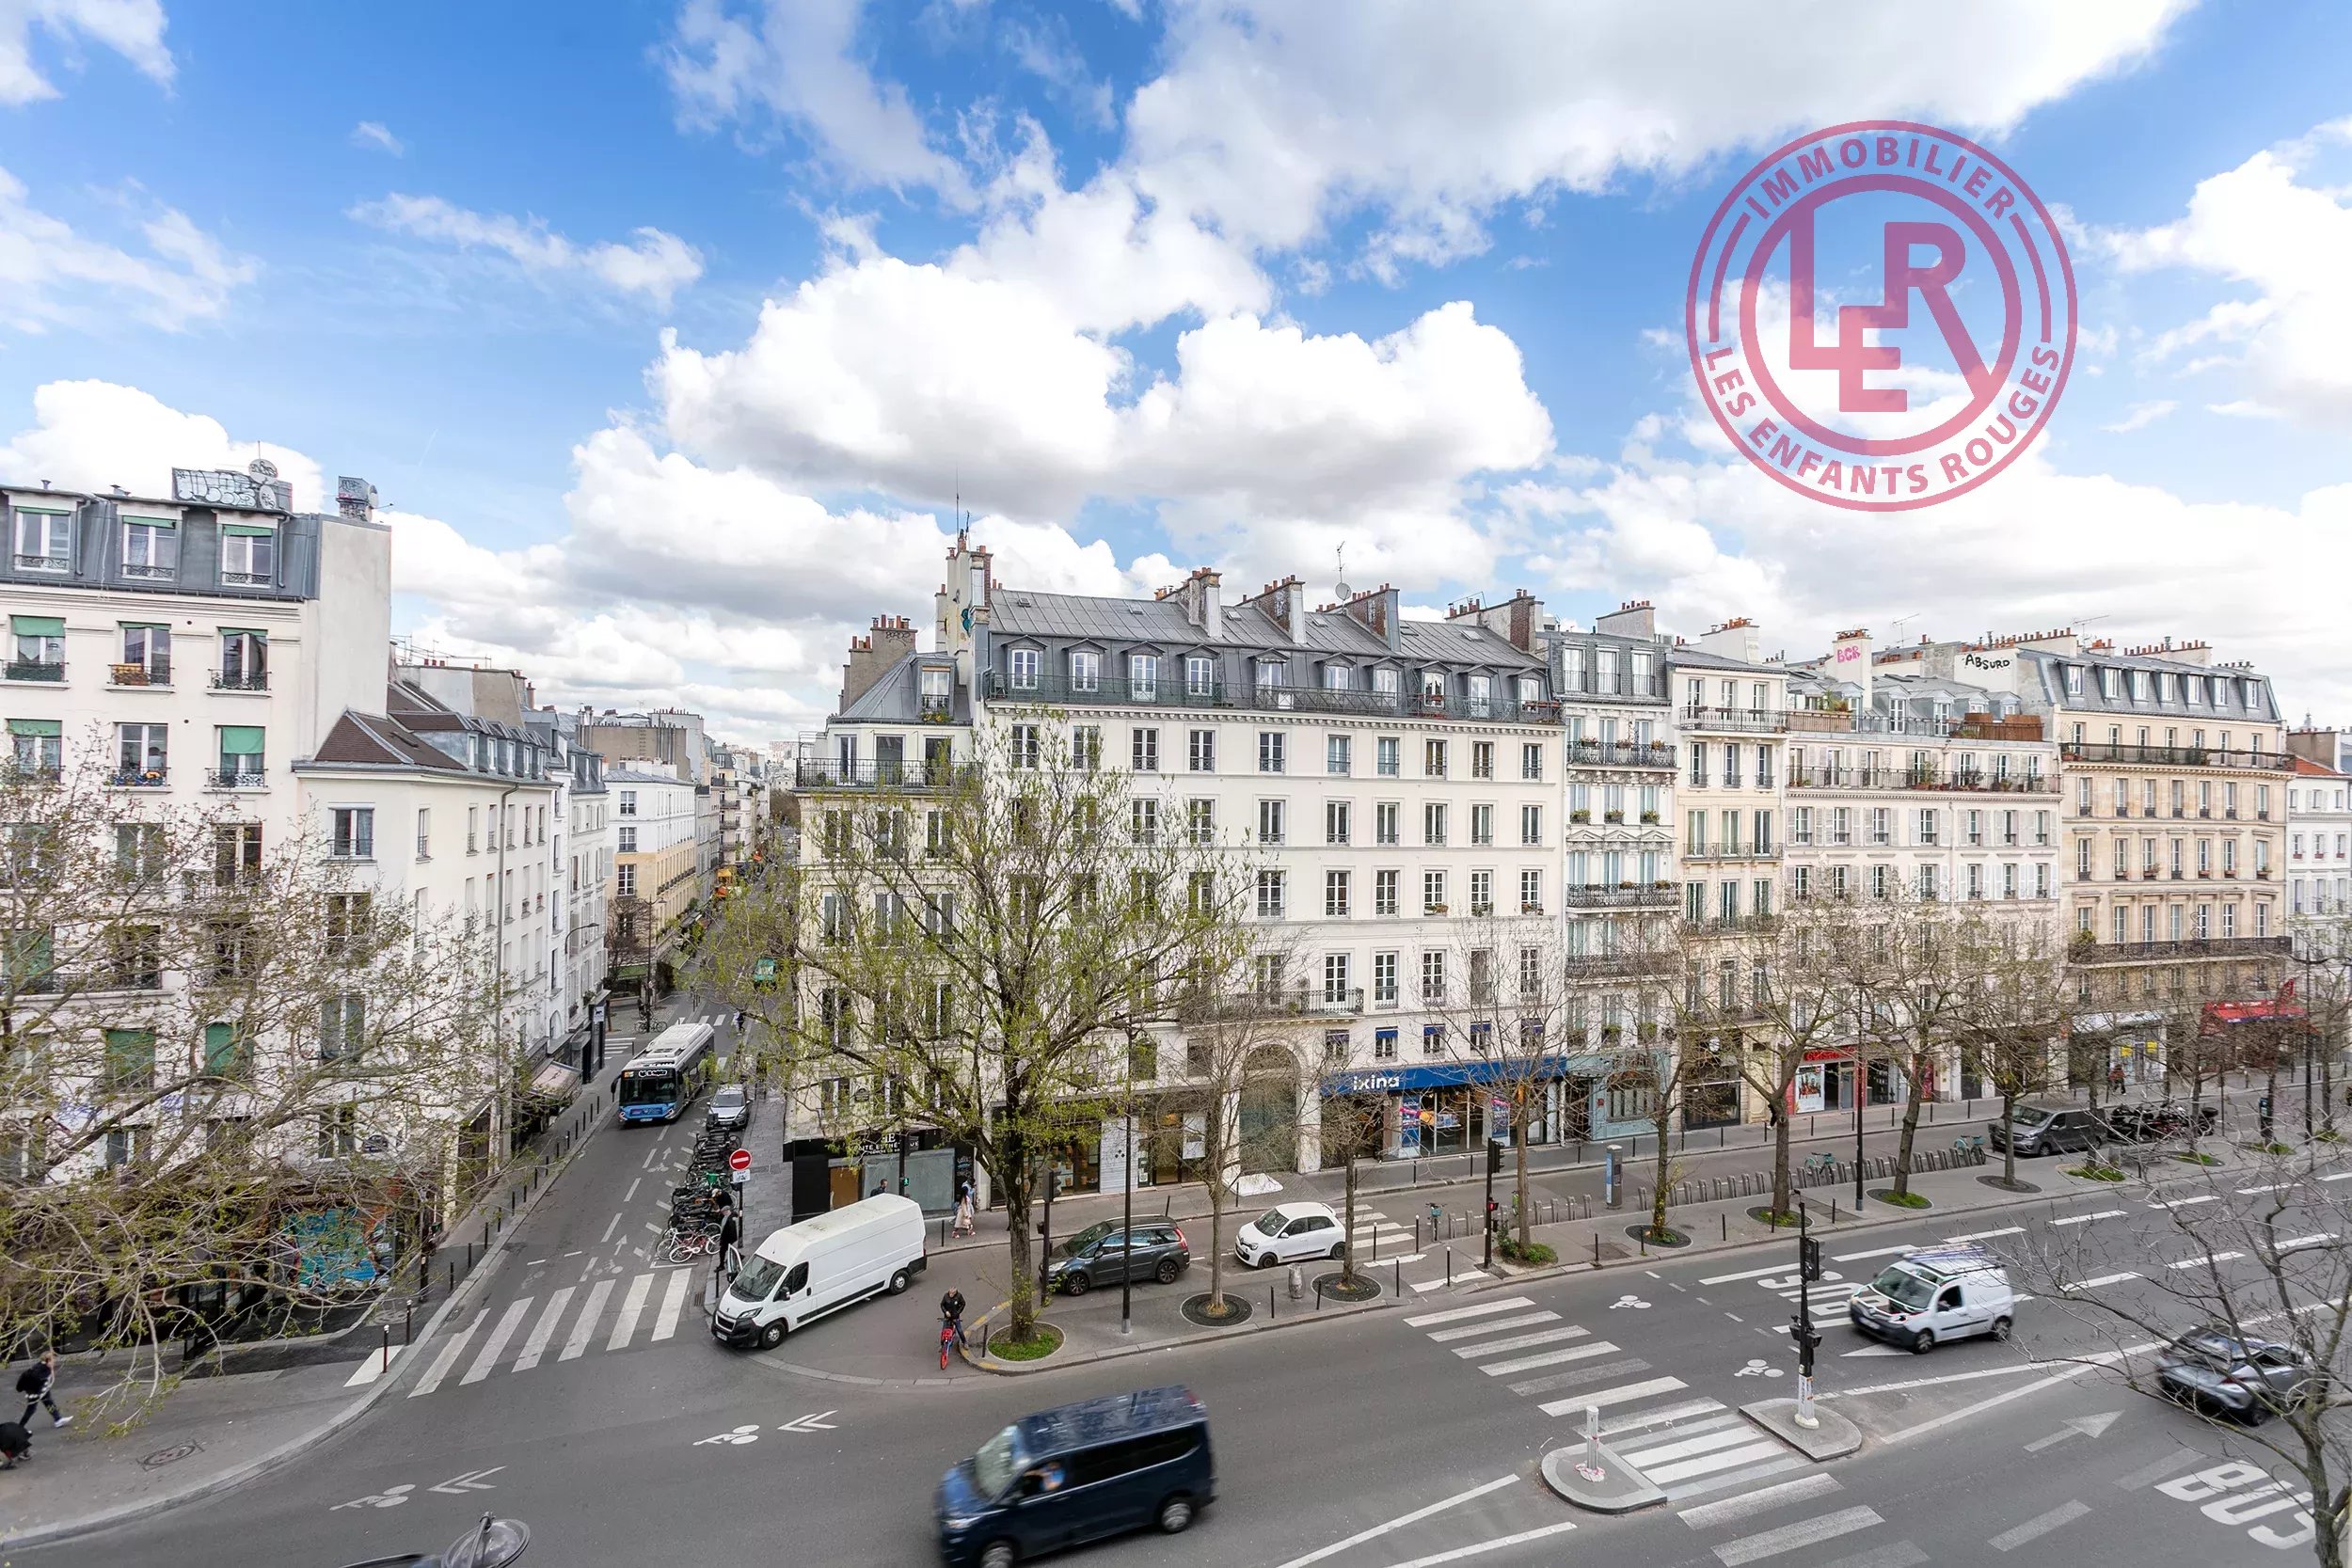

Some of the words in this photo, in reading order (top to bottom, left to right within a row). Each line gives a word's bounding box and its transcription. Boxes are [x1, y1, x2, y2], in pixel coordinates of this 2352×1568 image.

[1965, 654, 2010, 670] ABSURD
[1353, 1076, 1399, 1090] ixina
[2153, 1460, 2316, 1550] BUS
